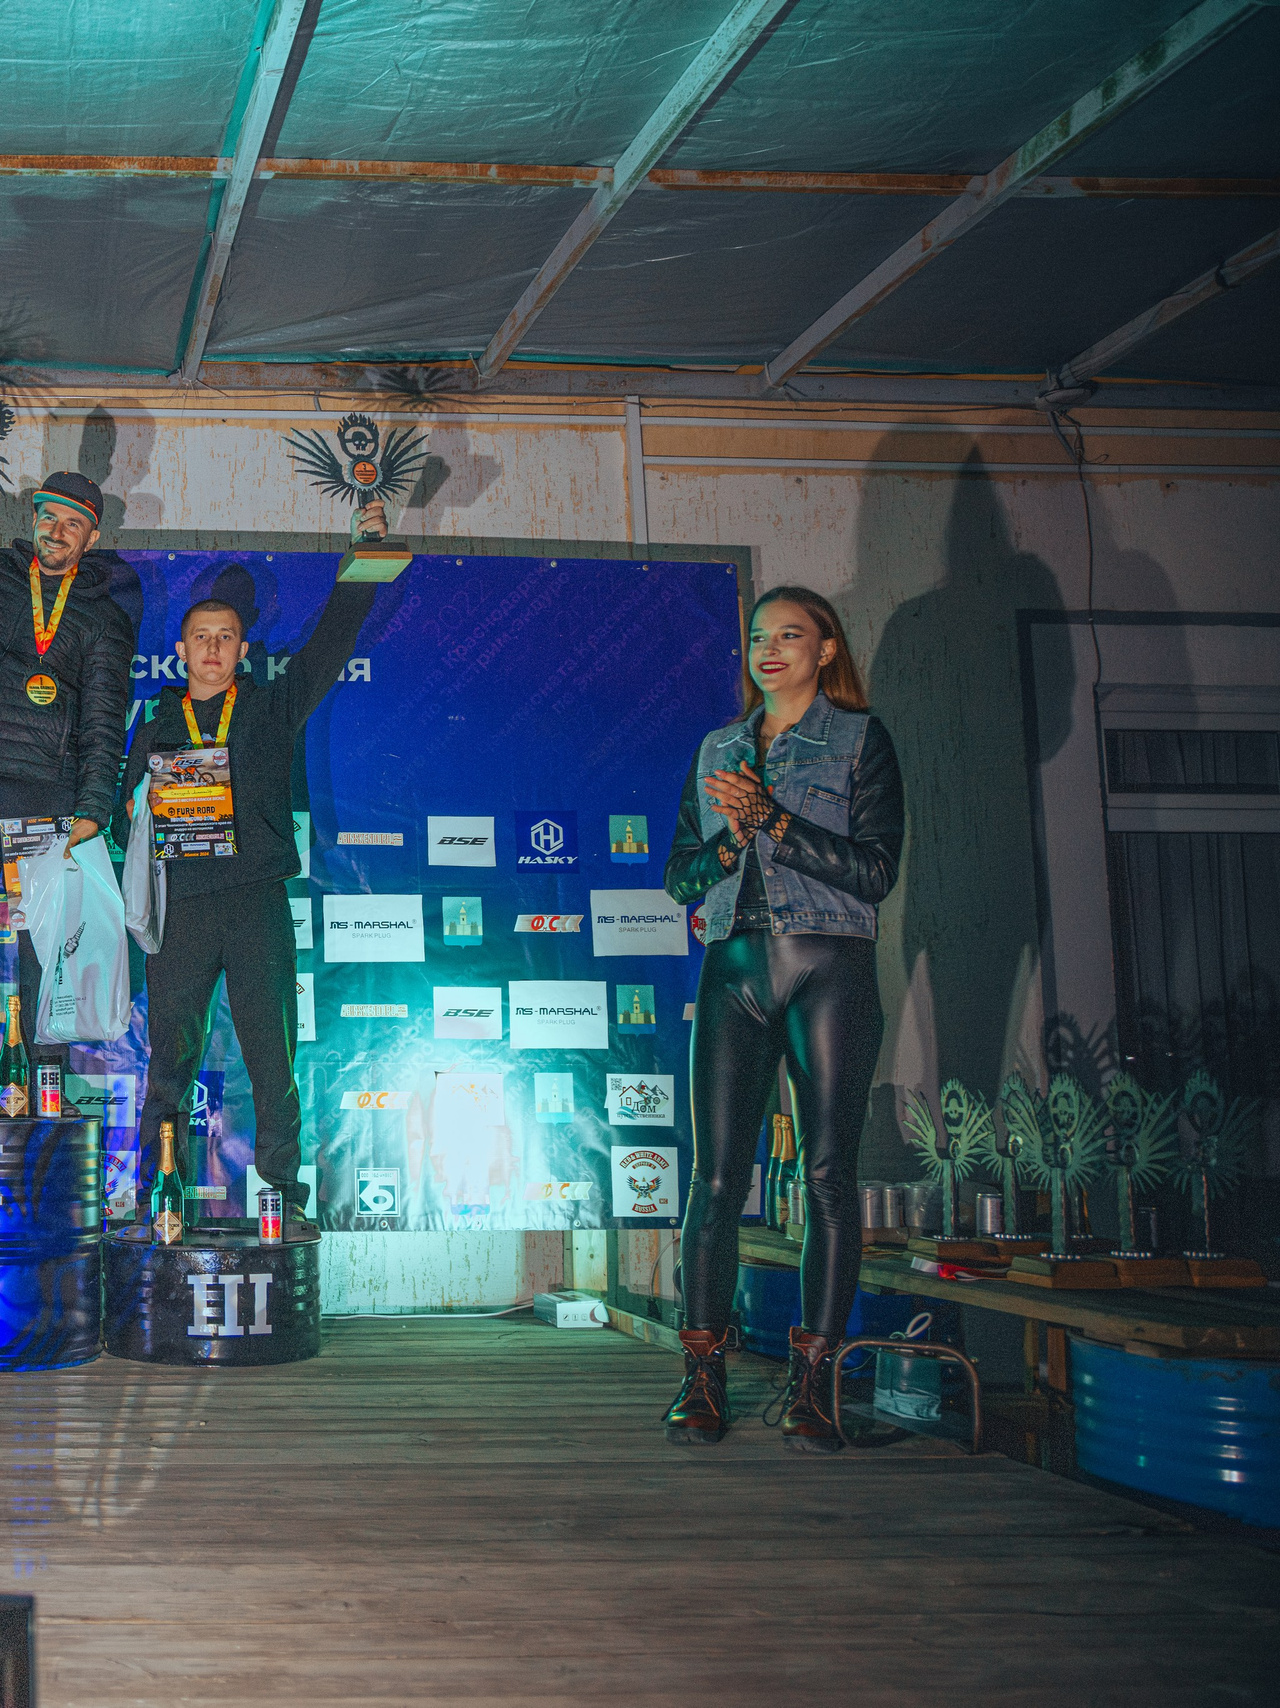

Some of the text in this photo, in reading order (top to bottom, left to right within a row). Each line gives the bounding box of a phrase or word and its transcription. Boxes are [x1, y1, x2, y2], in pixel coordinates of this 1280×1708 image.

[176, 806, 216, 816] FURY ROAD
[437, 836, 488, 846] BSE
[517, 856, 578, 865] HASKY
[442, 1008, 494, 1018] BSE
[74, 1096, 128, 1105] BSE
[631, 1101, 656, 1113] Дом
[187, 1273, 274, 1337] III
